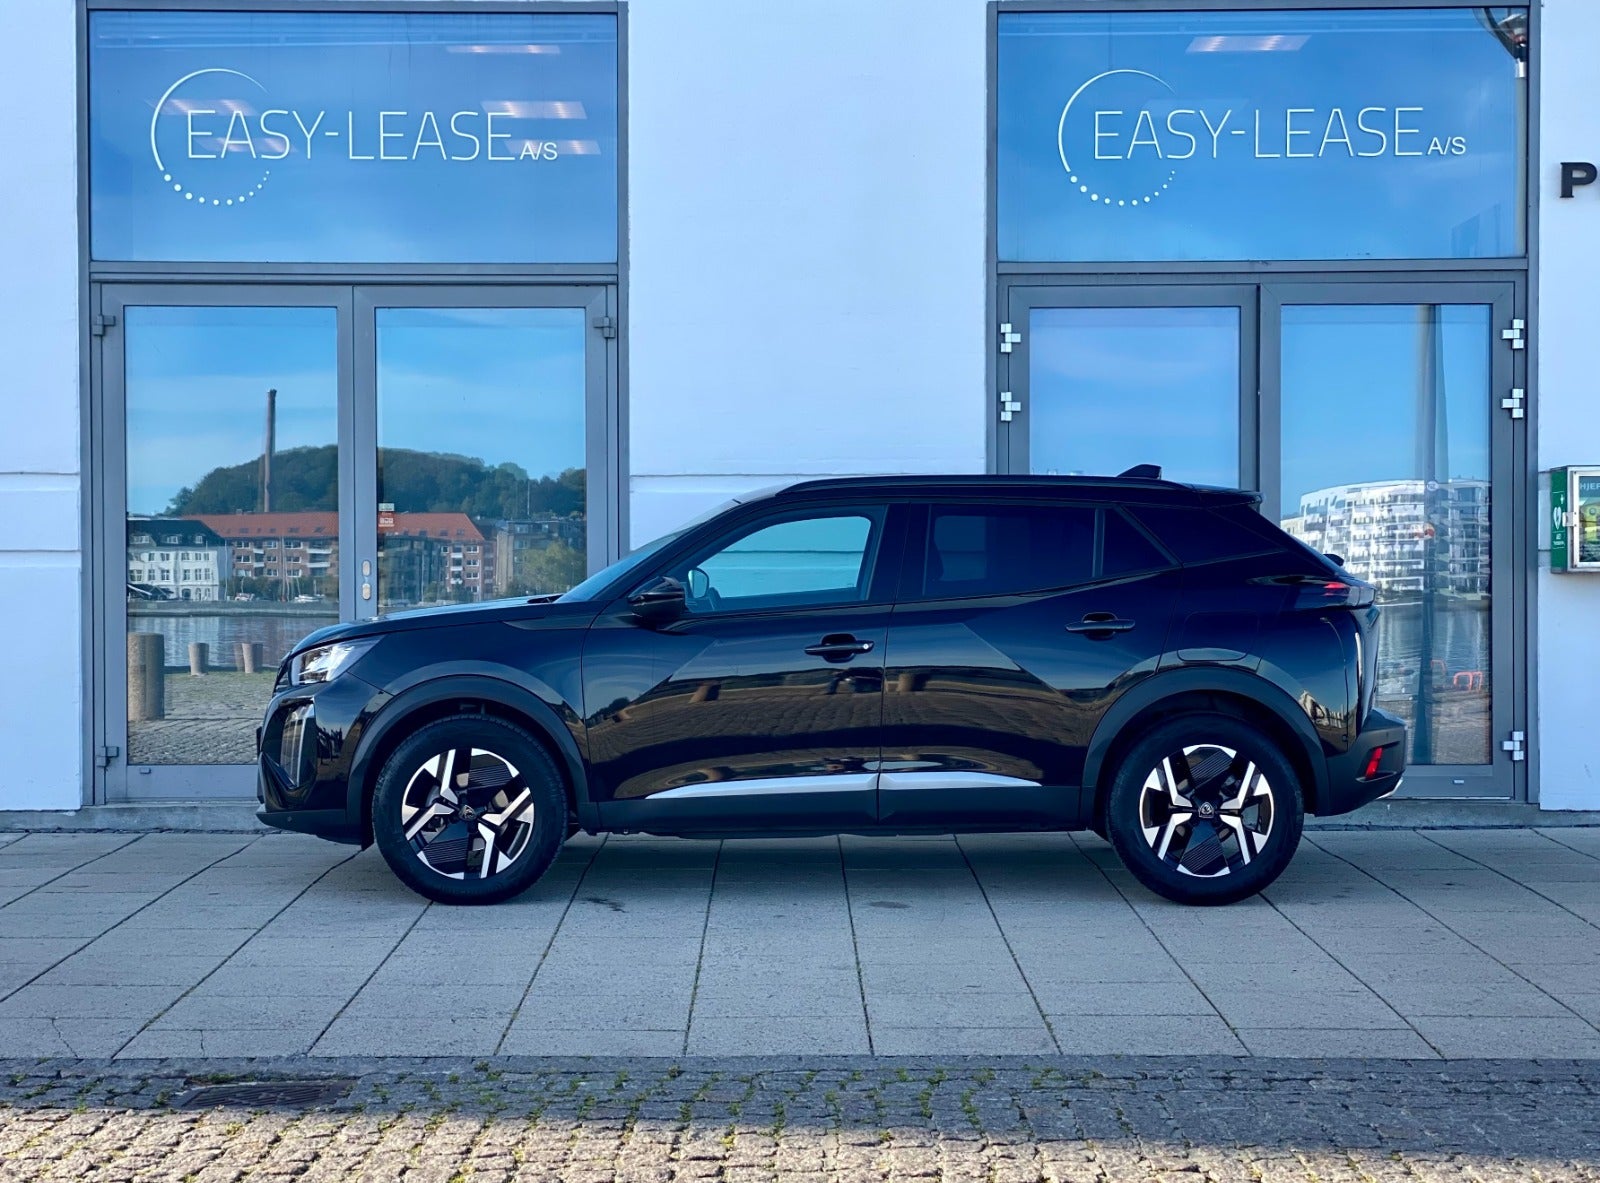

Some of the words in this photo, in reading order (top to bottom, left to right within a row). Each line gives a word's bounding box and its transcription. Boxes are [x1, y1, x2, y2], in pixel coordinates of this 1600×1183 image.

[187, 109, 516, 161] EASY-LEASE
[519, 141, 559, 161] A/S
[1094, 107, 1424, 159] EASY-LEASE
[1427, 136, 1467, 155] A/S
[1560, 162, 1598, 198] P
